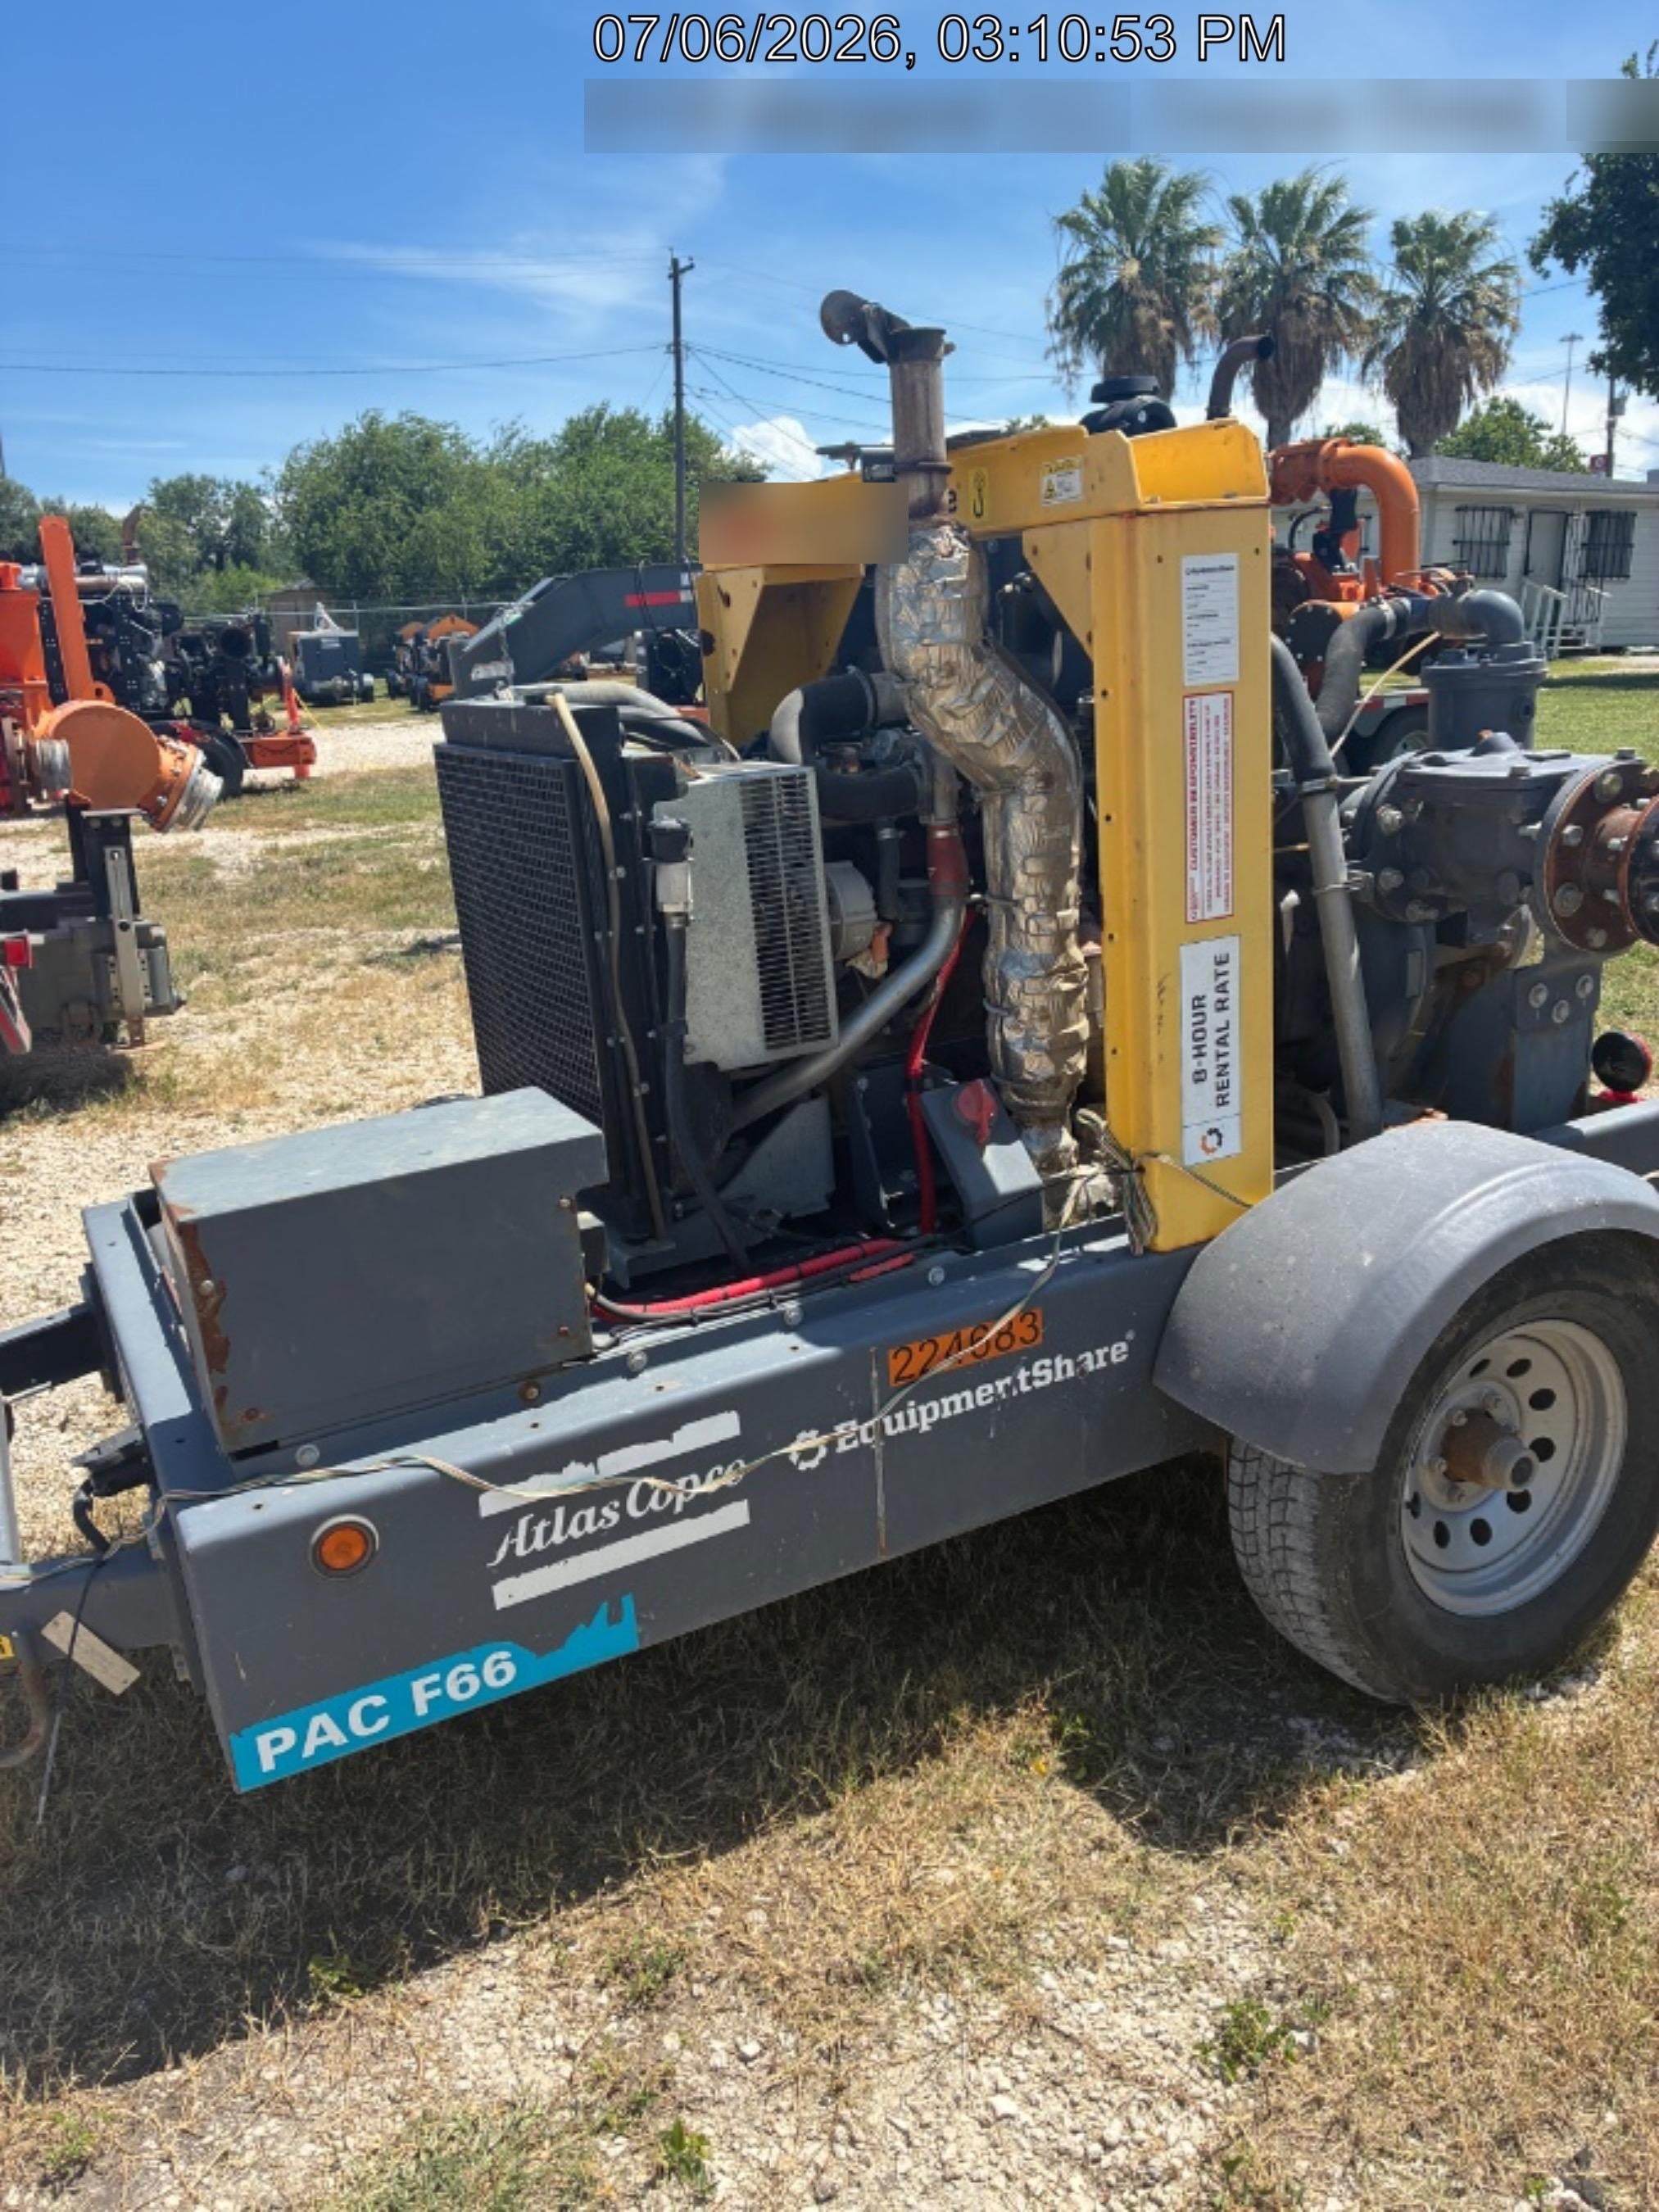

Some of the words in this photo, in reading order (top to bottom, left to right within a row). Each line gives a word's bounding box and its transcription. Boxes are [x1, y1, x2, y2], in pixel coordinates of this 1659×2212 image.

[1214, 952, 1230, 1012] RATE
[1191, 994, 1207, 1084] 8-HOUR
[1215, 1020, 1230, 1108] RENTAL
[487, 1498, 621, 1567] Atlas
[626, 1458, 747, 1517] Copco
[256, 1695, 391, 1773] PAC
[411, 1650, 517, 1716] F66
